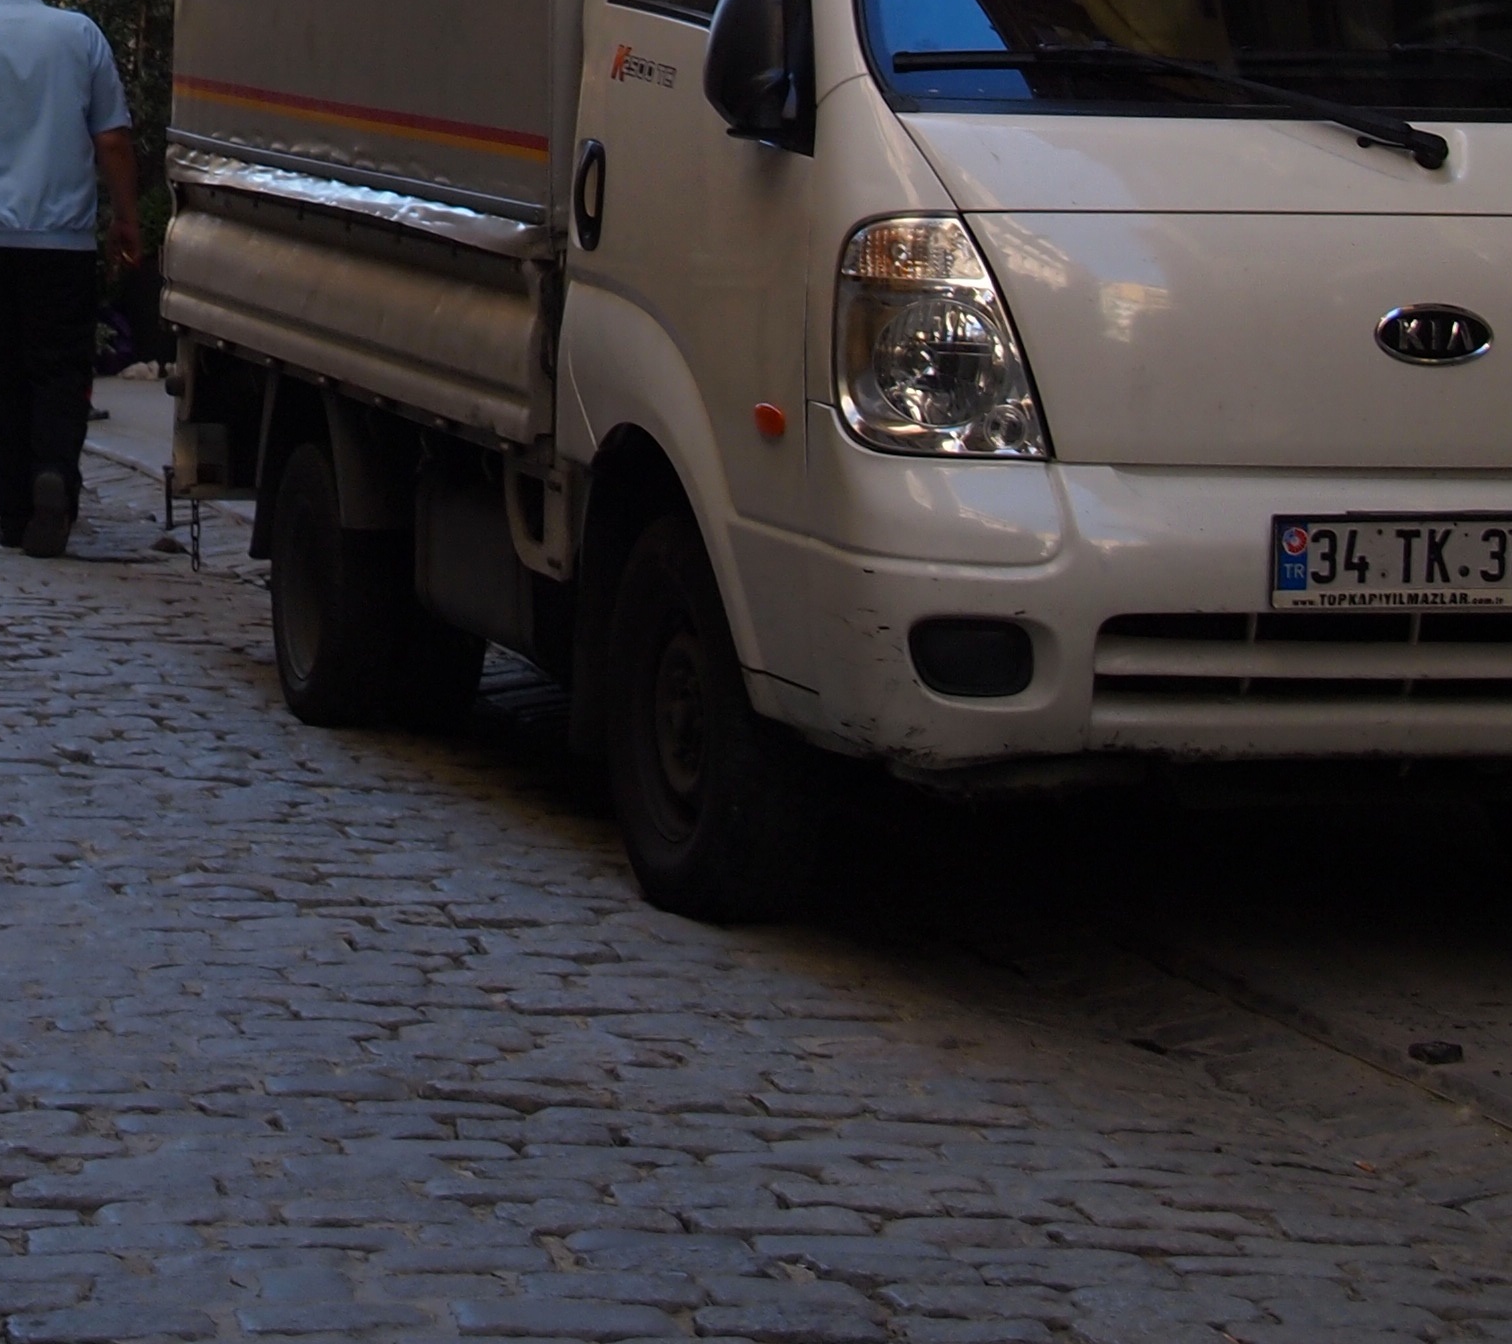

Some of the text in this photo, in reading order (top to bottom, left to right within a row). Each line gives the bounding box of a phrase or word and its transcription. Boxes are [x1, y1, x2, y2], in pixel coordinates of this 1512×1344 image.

[1397, 318, 1474, 351] KIA
[1284, 563, 1304, 579] TR
[1310, 529, 1370, 584] 34
[1480, 529, 1512, 583] 3
